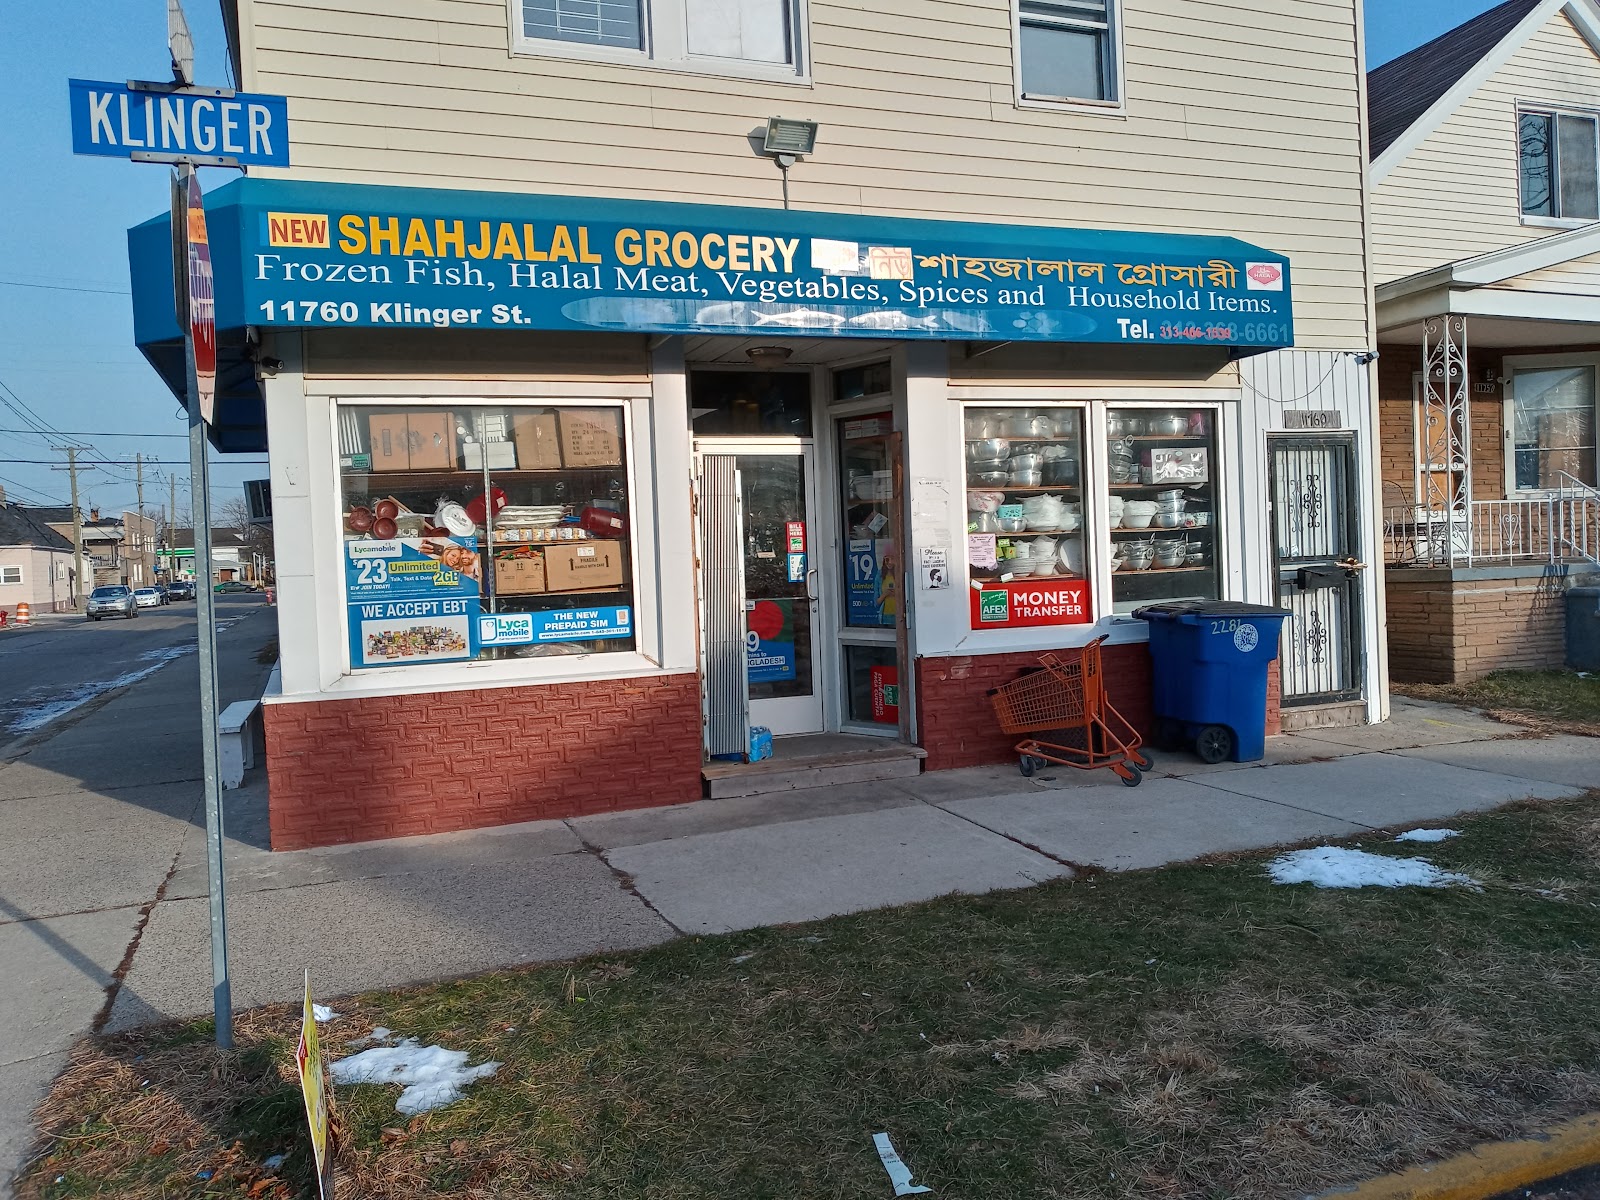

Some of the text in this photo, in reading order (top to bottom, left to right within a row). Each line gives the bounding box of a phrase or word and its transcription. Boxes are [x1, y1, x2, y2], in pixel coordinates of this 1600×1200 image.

[88, 91, 273, 156] KLINGER
[270, 214, 800, 274] NEW SHAHJALAL GROCERY
[870, 247, 1240, 288] নিউ শাহজালাল গ্রোসারী
[254, 253, 1278, 314] Frozen Fish, Halal Meat, Vegetables, Spices and Household Items.
[259, 299, 532, 328] 11760 Klinger St.
[1117, 318, 1155, 339] Tel.
[354, 544, 396, 553] Lycamobile
[352, 559, 388, 585] $23
[389, 562, 439, 572] Unlimited
[1013, 590, 1082, 606] MONEY
[362, 599, 468, 618] WE ACCEPT EBT
[553, 612, 573, 620] THE
[983, 604, 1007, 614] AFEX
[1014, 604, 1082, 617] TRANSFER
[498, 619, 529, 630] Lyca
[544, 619, 608, 631] PREPAID SIM
[1211, 619, 1241, 634] 2281
[499, 629, 529, 637] mobile
